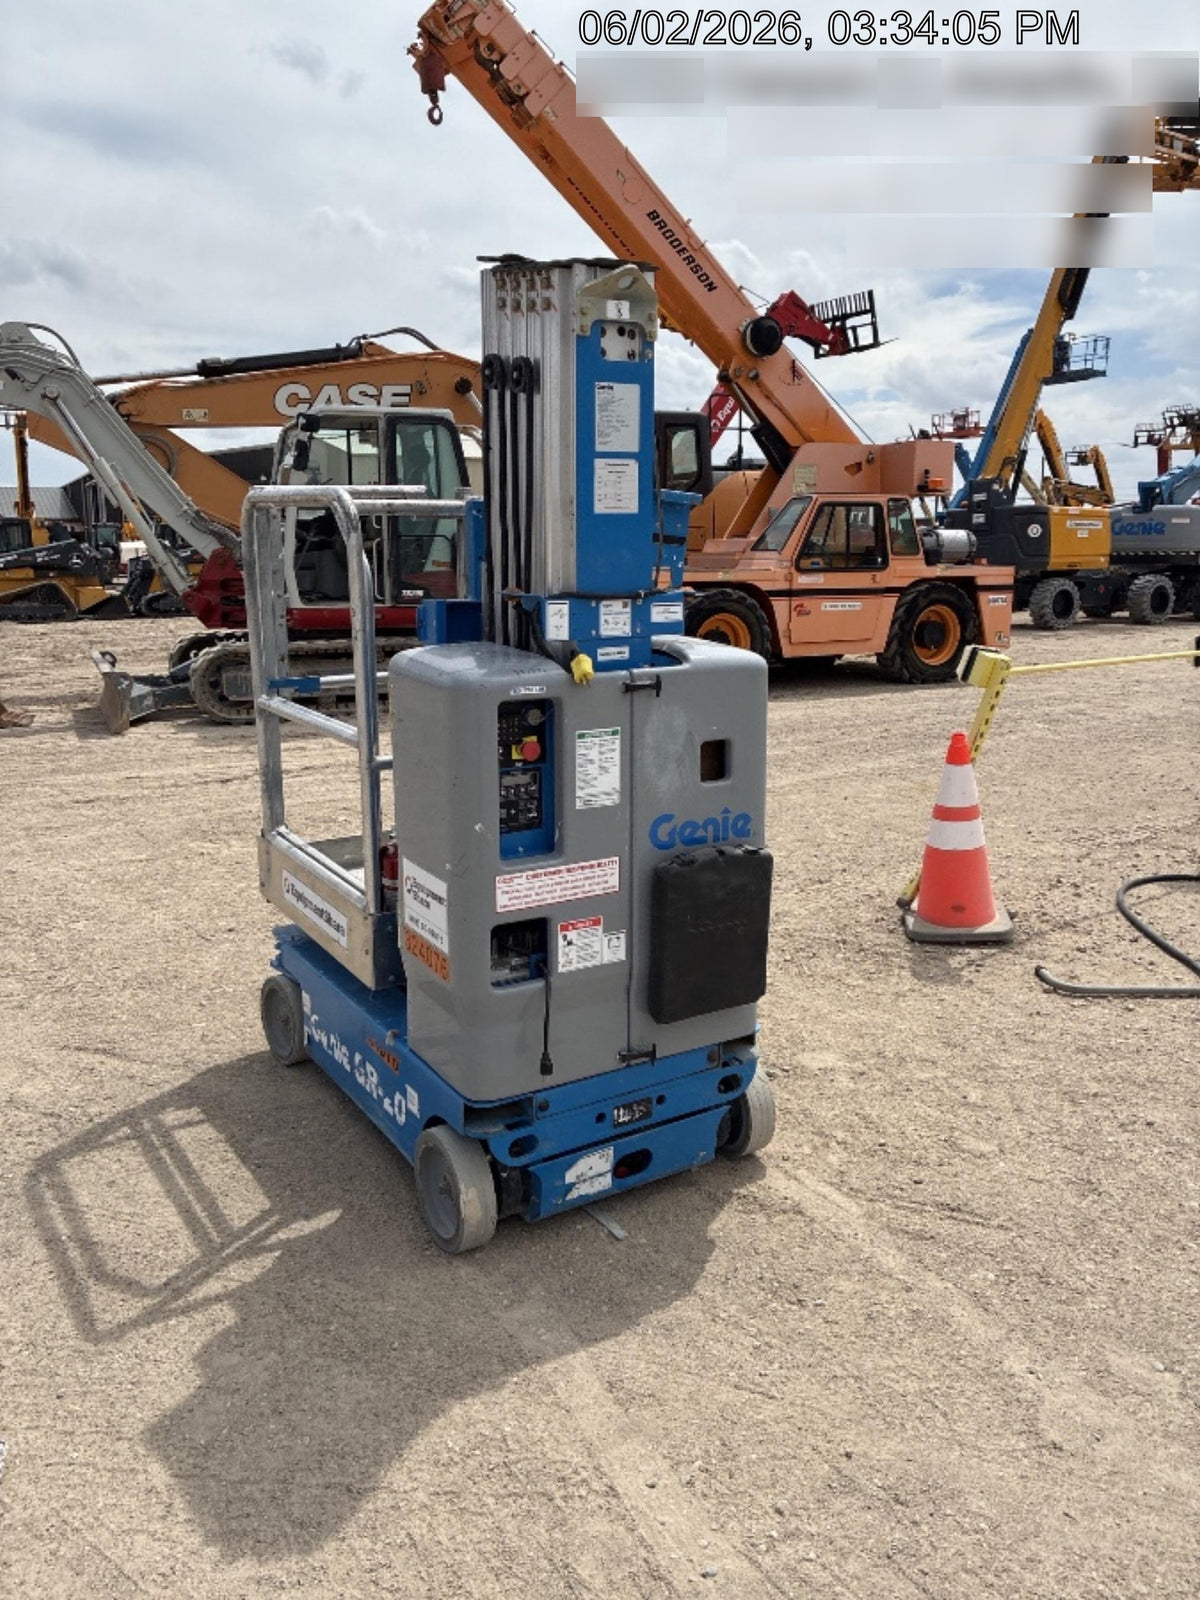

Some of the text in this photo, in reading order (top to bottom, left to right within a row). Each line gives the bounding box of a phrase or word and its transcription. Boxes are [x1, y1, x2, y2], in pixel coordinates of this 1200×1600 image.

[646, 209, 718, 293] BRODERSON
[273, 381, 413, 418] CASE
[1112, 517, 1166, 536] Genie
[649, 806, 752, 851] Genie
